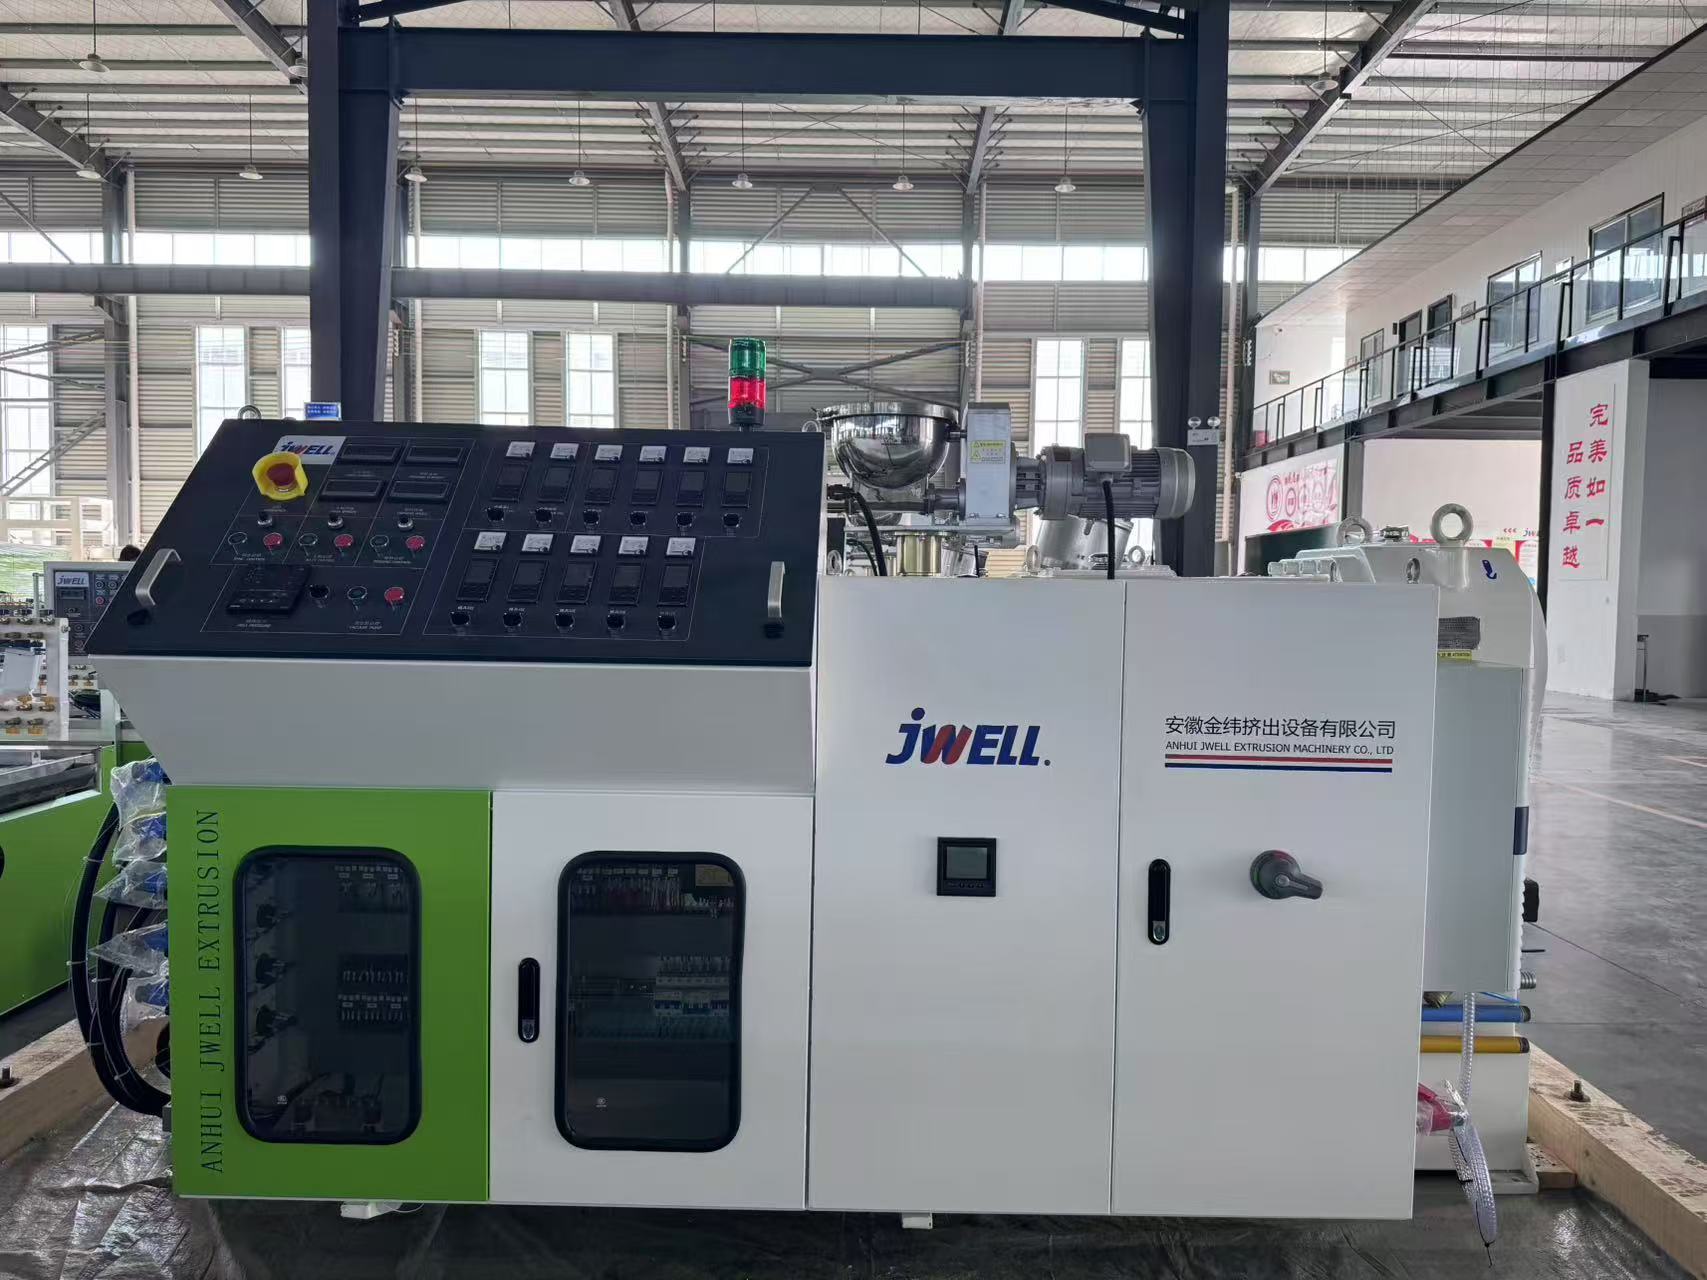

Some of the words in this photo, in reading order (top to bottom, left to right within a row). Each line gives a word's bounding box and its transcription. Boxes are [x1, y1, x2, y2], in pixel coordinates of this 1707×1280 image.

[1562, 441, 1584, 569] 品质卓越
[1585, 403, 1609, 527] 完美如一
[1165, 716, 1396, 739] 安徽金纬挤出设备有限公司
[1165, 741, 1198, 751] ANHUI
[1200, 741, 1231, 751] JWELL
[1235, 743, 1292, 753] EXTRUSION
[1294, 744, 1351, 754] MACHINERY
[1354, 745, 1373, 755] CO.,
[1376, 745, 1394, 755] LTD
[196, 810, 221, 973] EXTRUSION
[198, 986, 225, 1073] JWELL
[200, 1089, 224, 1174] ANHUI
